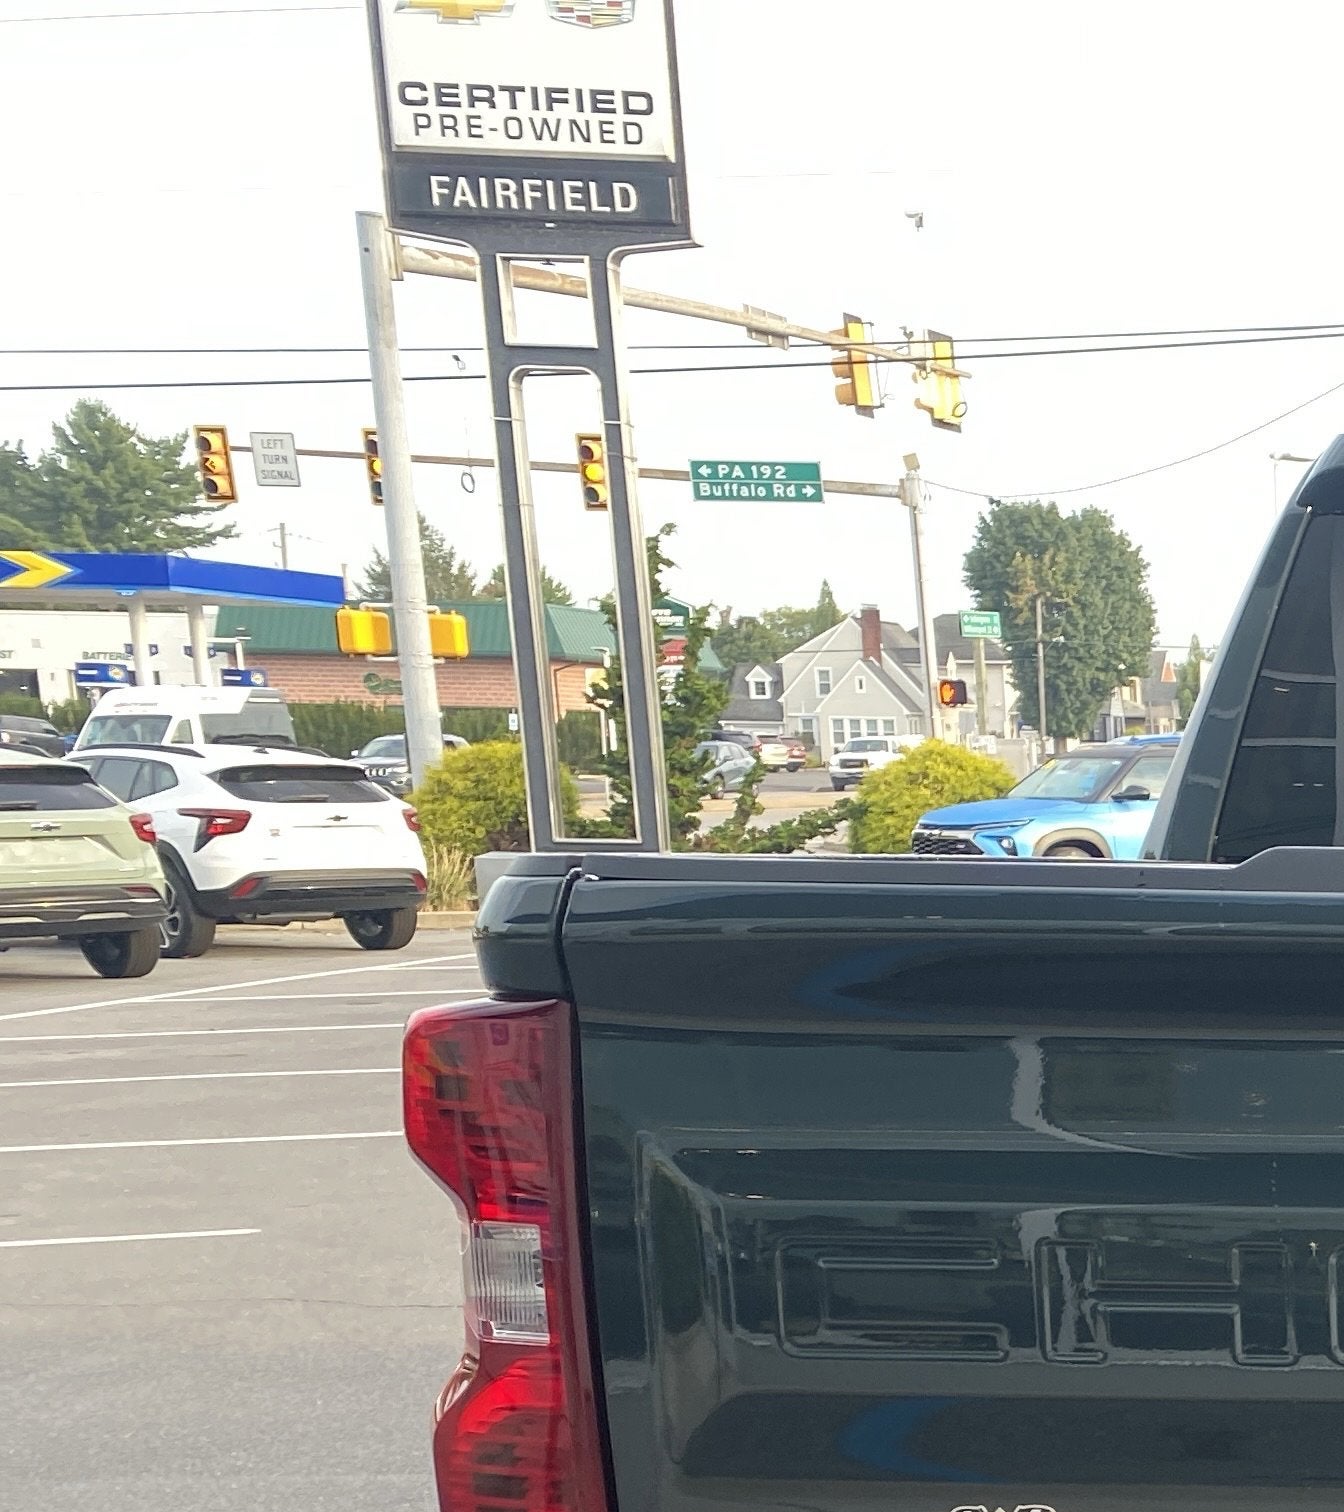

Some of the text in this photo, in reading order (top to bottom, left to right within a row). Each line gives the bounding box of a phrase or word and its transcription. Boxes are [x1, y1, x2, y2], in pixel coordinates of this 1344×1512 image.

[397, 81, 654, 116] CERTIFIED
[412, 112, 643, 145] PRE-OWNED
[429, 174, 639, 213] FAIRFIELD
[260, 438, 284, 450] LEFT
[262, 453, 289, 465] TURN
[260, 469, 296, 481] SIGNAL
[717, 464, 787, 480] PA 192
[699, 482, 796, 498] Buffalo Rd
[81, 650, 134, 661] BATTERIE
